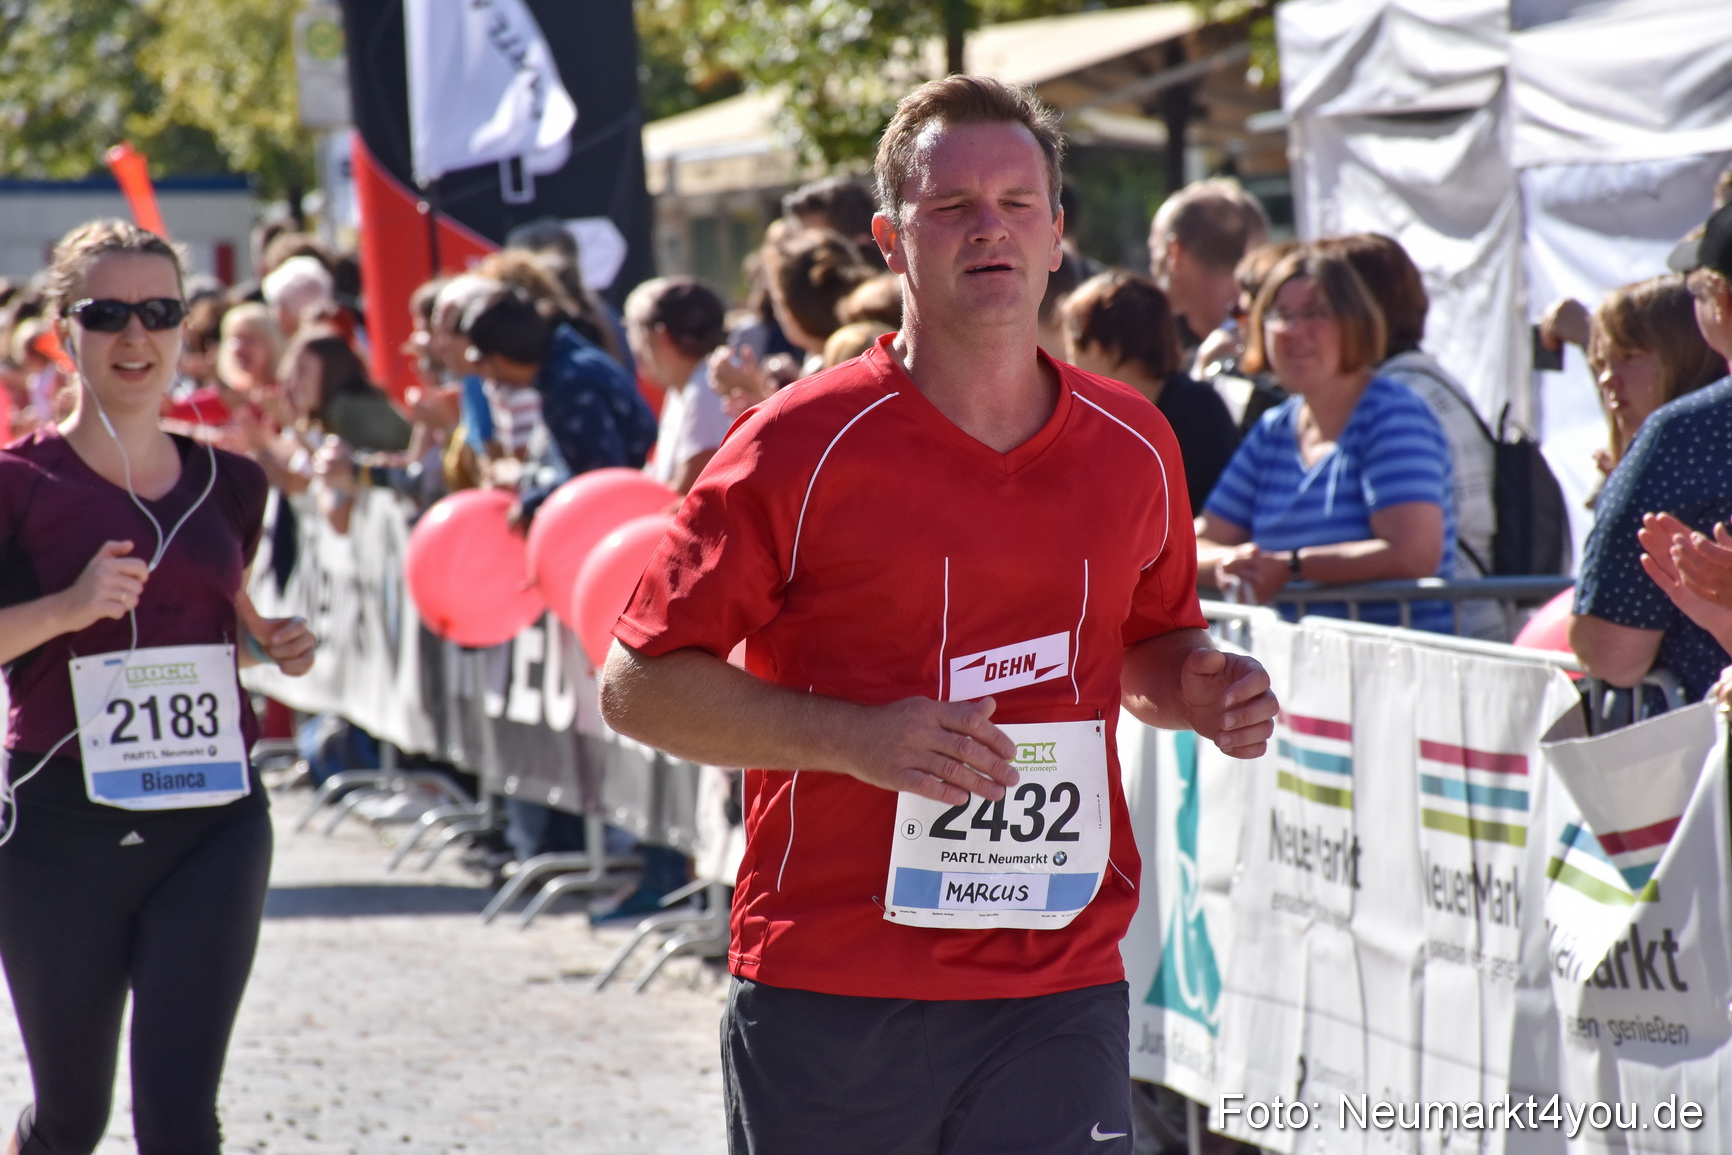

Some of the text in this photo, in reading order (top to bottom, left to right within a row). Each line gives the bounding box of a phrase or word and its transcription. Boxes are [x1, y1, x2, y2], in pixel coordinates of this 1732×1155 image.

[126, 663, 198, 683] BOCK
[984, 652, 1037, 682] DEHN
[106, 692, 219, 745] 2183
[123, 747, 205, 761] PARTL Neumarkt
[1008, 742, 1057, 764] CK
[1030, 765, 1058, 773] concepts
[141, 771, 206, 792] Bianca
[929, 782, 1081, 843] 2432
[907, 824, 916, 836] B
[941, 851, 1048, 864] PARTL Neumarkt
[945, 880, 1029, 904] MARCUS
[1585, 923, 1689, 992] arkt
[1607, 1014, 1690, 1046] genießen
